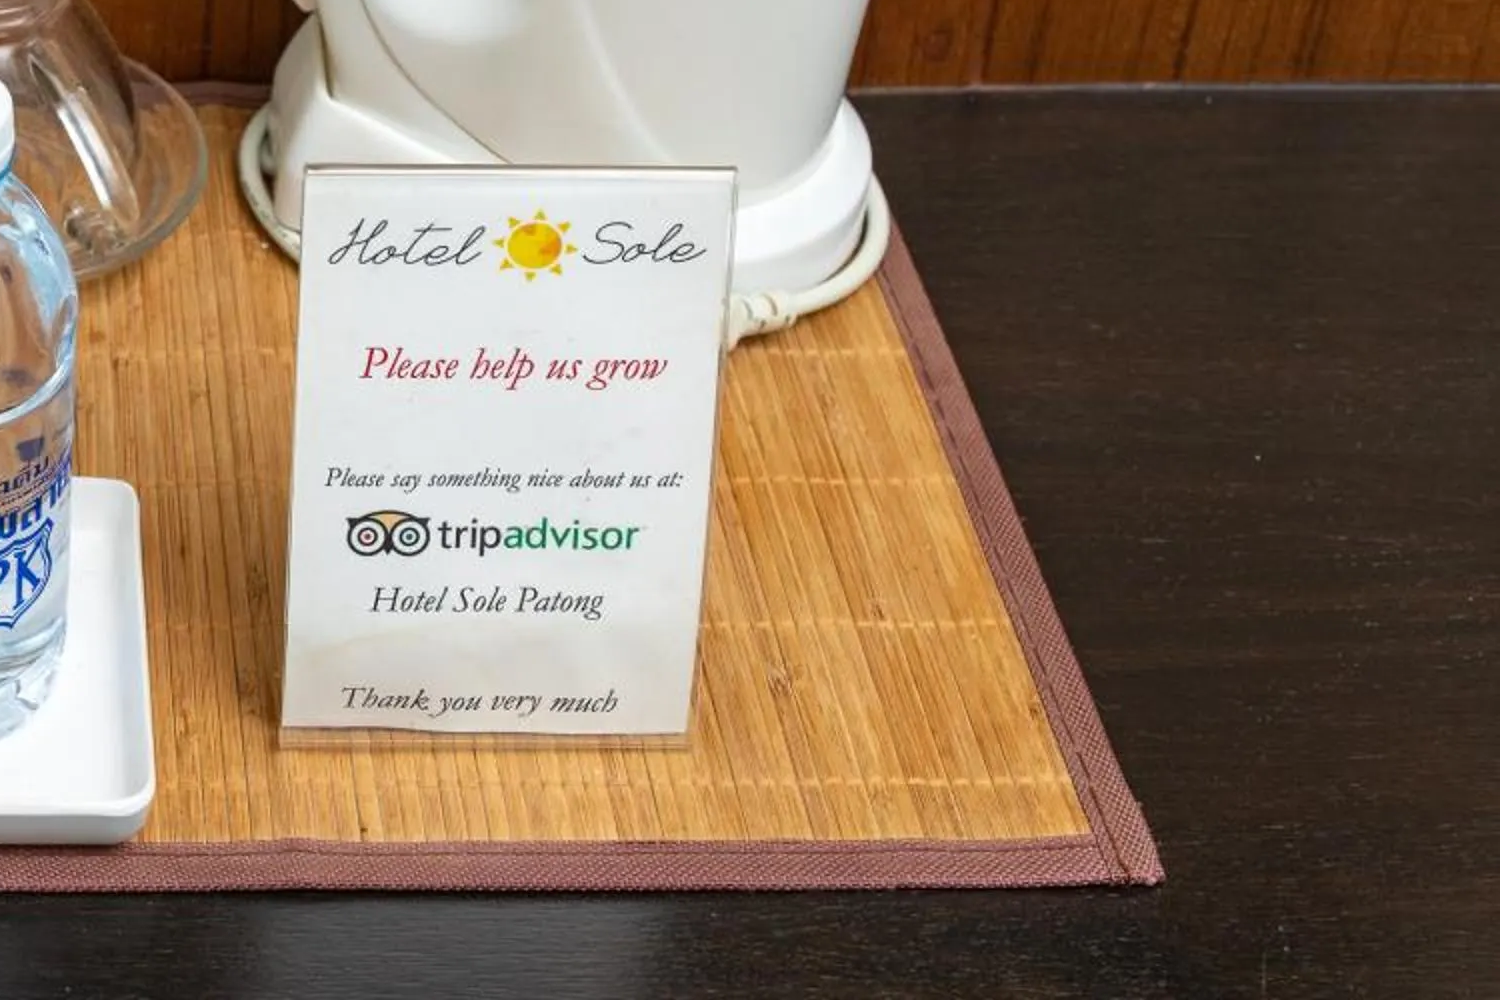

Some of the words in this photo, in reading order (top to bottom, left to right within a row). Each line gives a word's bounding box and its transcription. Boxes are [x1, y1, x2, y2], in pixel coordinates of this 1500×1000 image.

[327, 217, 487, 266] Hotel
[582, 221, 708, 265] Sole
[359, 346, 459, 380] Please
[469, 346, 535, 391] help
[546, 357, 583, 380] us
[585, 357, 668, 391] grow
[324, 467, 385, 488] Please
[390, 473, 422, 494] say
[427, 467, 522, 493] something
[527, 469, 563, 488] nice
[569, 467, 626, 489] about
[630, 474, 652, 488] us
[657, 472, 684, 488] at:
[437, 517, 641, 557] tripadvisor
[370, 586, 448, 614] Hotel
[452, 586, 507, 614] Sole
[514, 586, 604, 621] Patong
[341, 687, 429, 710] Thank
[428, 695, 483, 718] you
[491, 694, 543, 717] very
[549, 688, 619, 713] much
